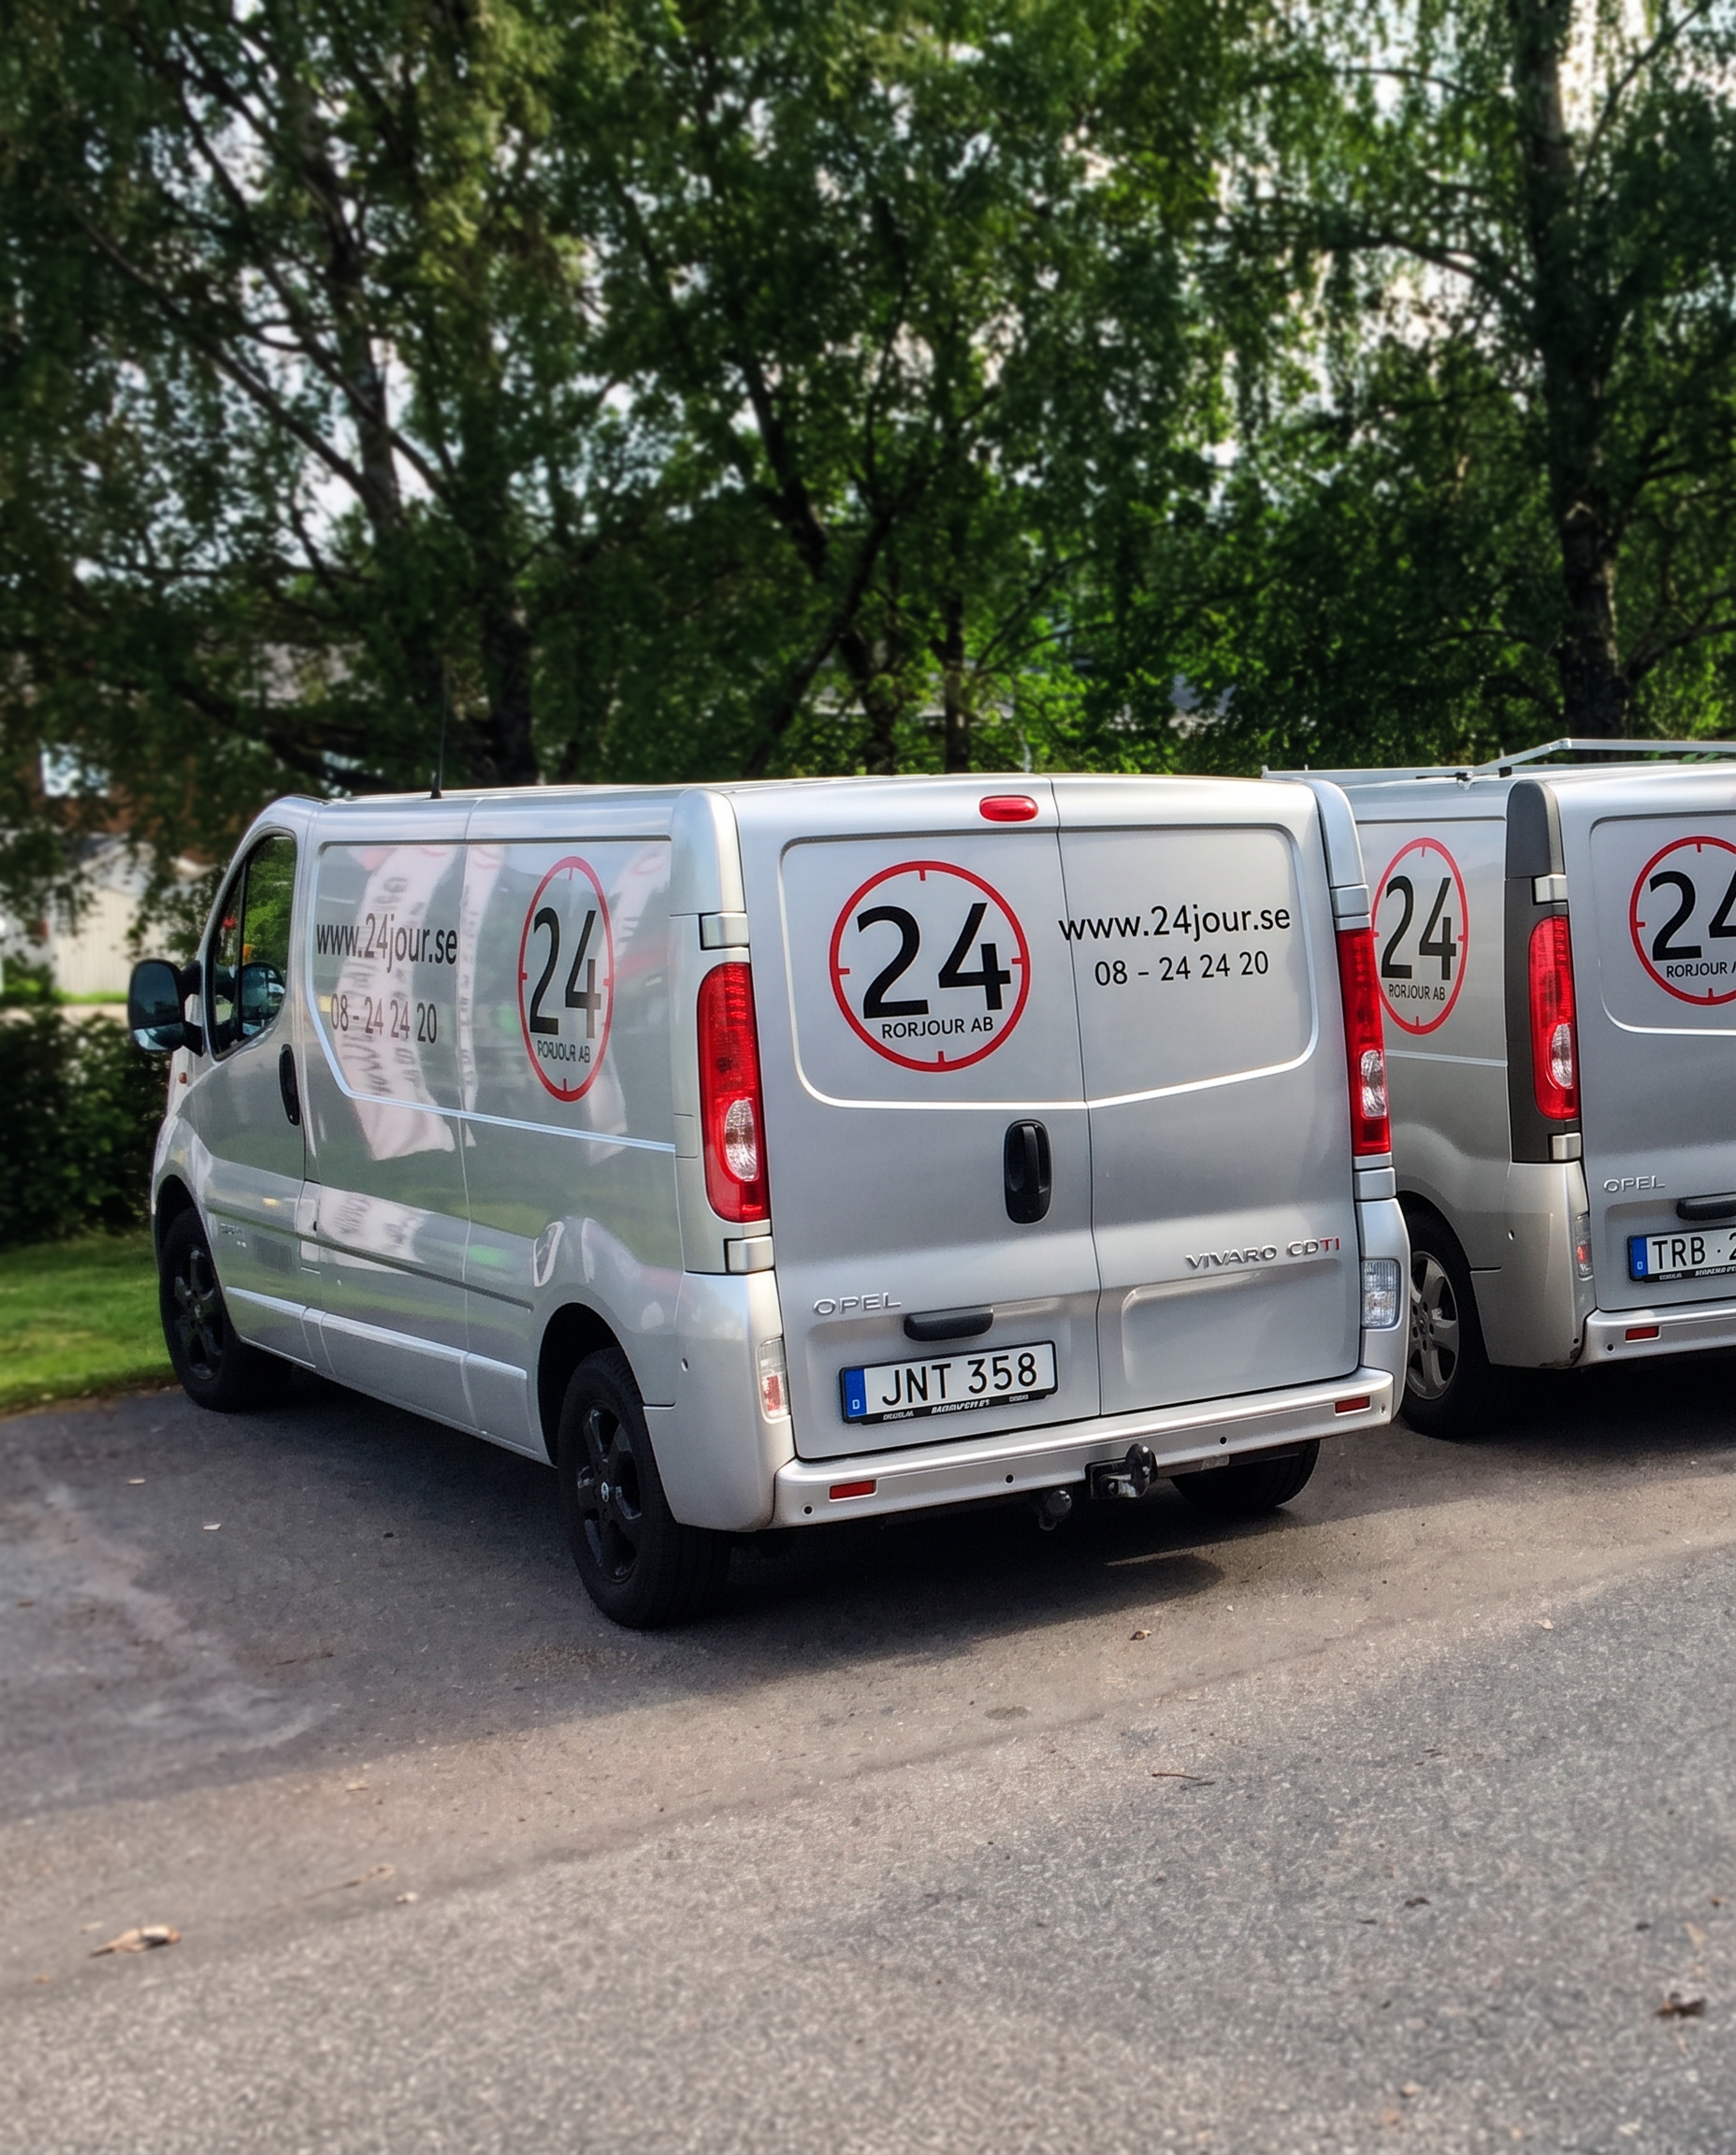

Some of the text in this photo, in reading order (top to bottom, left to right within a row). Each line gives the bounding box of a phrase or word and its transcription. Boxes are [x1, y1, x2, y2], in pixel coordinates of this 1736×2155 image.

[1058, 904, 1291, 943] www.24jour.se
[1381, 875, 1457, 981] 24
[316, 912, 458, 975] www.24jour.se
[855, 902, 1012, 1020] 24
[528, 906, 602, 1039] 24
[1094, 960, 1128, 986] 08
[1159, 955, 1191, 981] 24
[1199, 952, 1231, 978] 24
[1239, 950, 1269, 976] 20
[1666, 961, 1729, 978] RORJOUR
[1432, 986, 1446, 1001] AB
[330, 992, 349, 1032] 08
[364, 996, 384, 1035] 24
[389, 999, 411, 1039] 24
[416, 1001, 438, 1044] 20
[881, 1016, 994, 1039] RORJOUR AB
[578, 1045, 590, 1063] AB
[1603, 1175, 1666, 1193] OPEL
[1185, 1236, 1340, 1270] VIVARO CDTI
[1652, 1236, 1706, 1269] TRB
[813, 1292, 902, 1315] OPEL
[881, 1352, 1037, 1406] JNT 358
